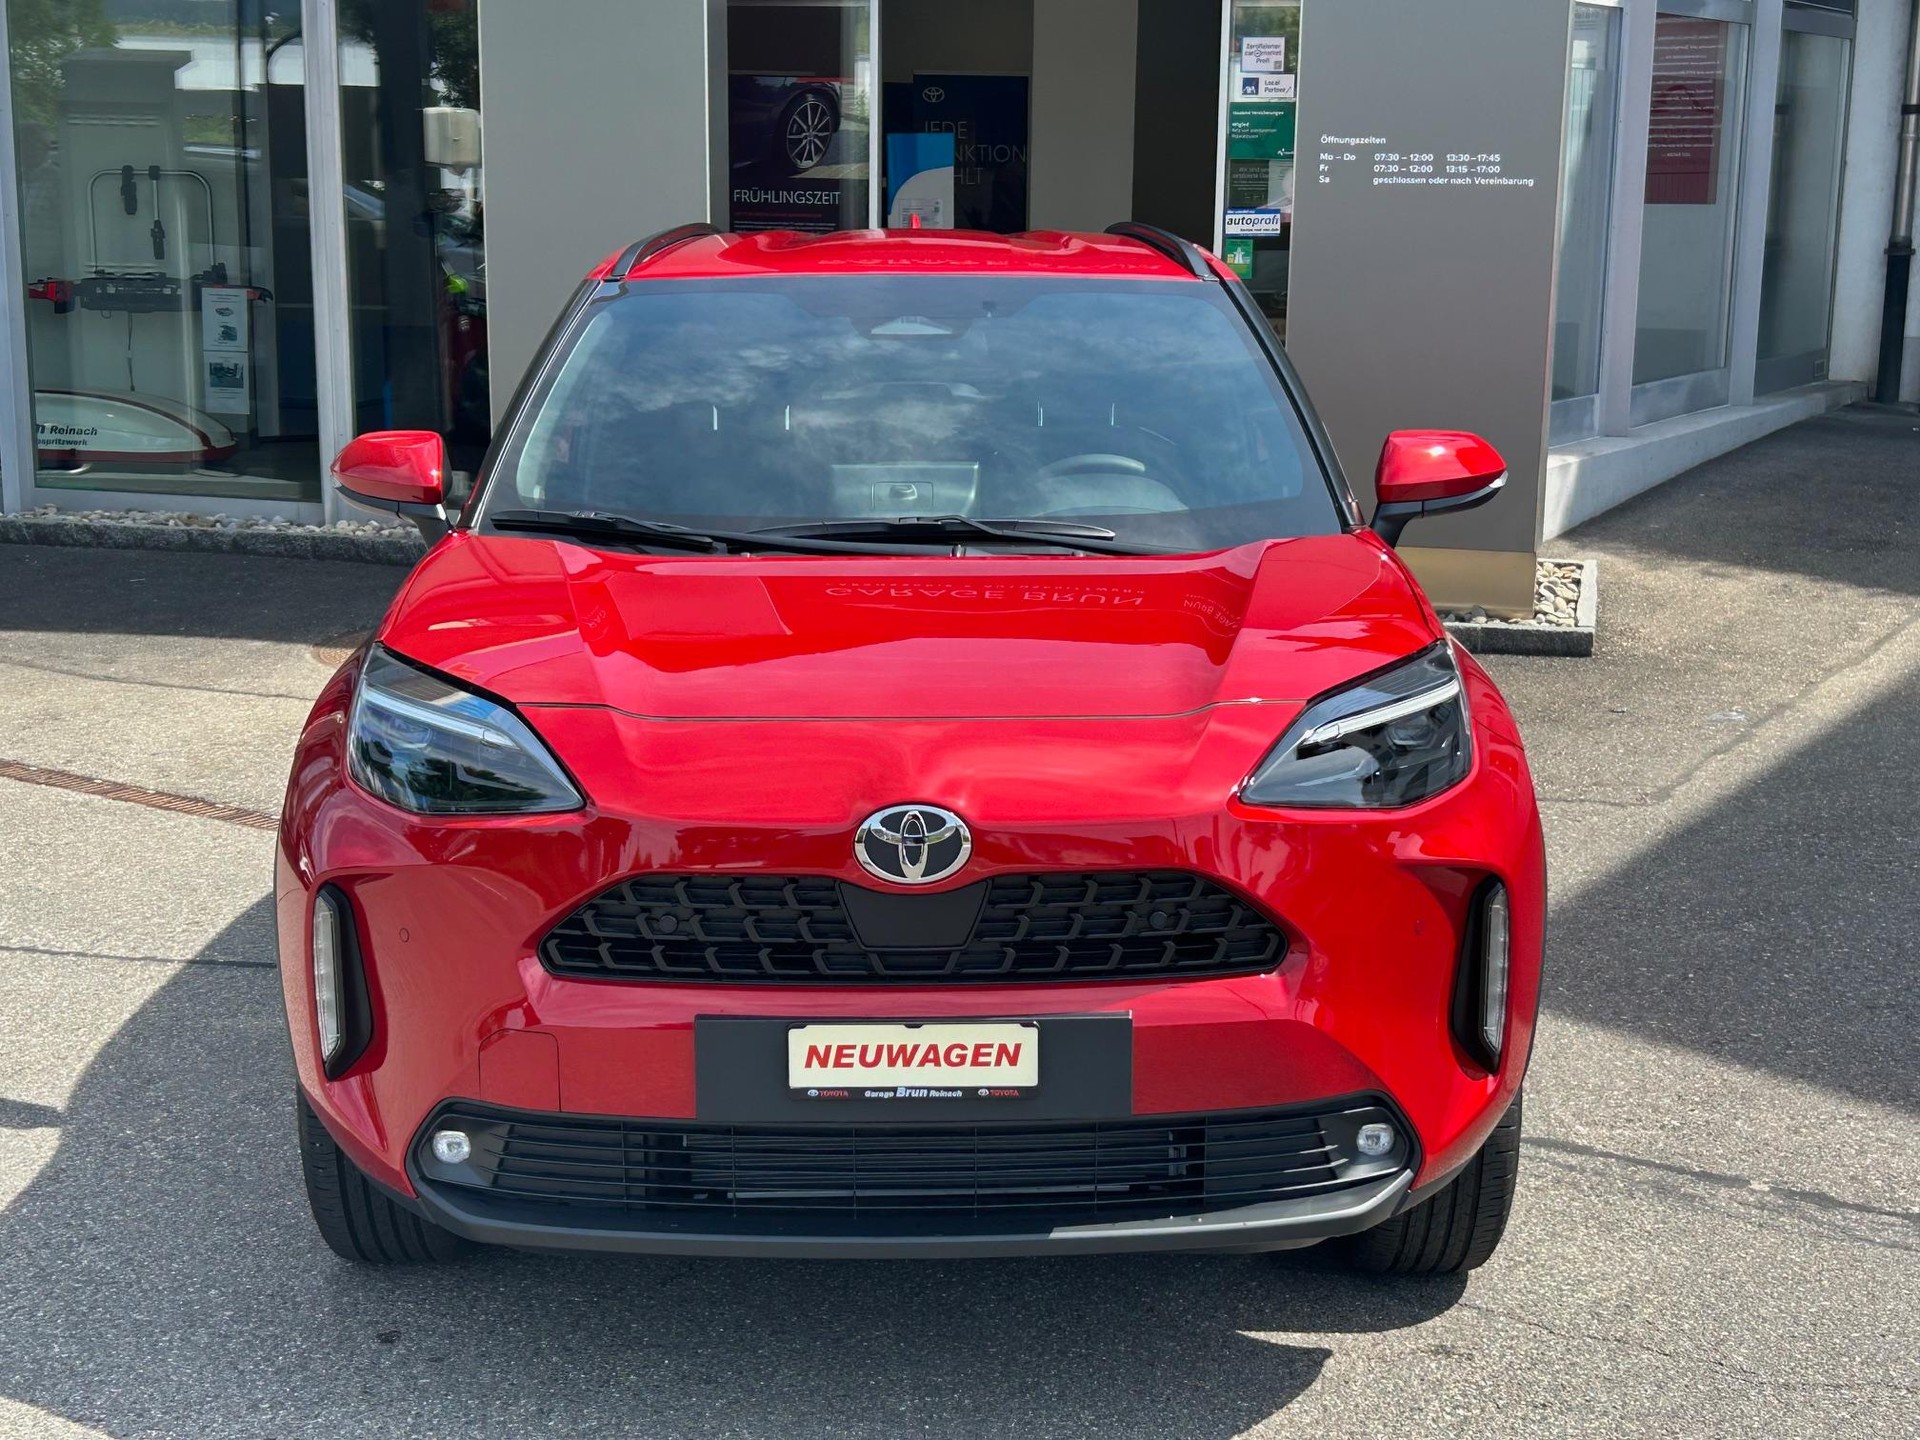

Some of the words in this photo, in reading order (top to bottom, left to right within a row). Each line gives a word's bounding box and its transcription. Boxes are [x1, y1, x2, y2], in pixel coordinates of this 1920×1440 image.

[1320, 134, 1386, 146] Öffnungszeiten
[954, 144, 1026, 162] NKTION
[1374, 153, 1399, 161] 07:30
[1409, 153, 1434, 161] 12:00
[1320, 164, 1328, 172] Fr
[1373, 164, 1398, 172] 07:30
[954, 167, 983, 185] HLT
[1319, 175, 1330, 183] Sa
[1373, 176, 1426, 185] geschlossen
[1428, 176, 1448, 184] oder
[1450, 176, 1471, 184] nach
[1474, 177, 1534, 187] Vereinbarung
[733, 187, 841, 205] FRÜHLINGSZEIT
[1226, 215, 1279, 227] autoprofi
[50, 425, 98, 436] Reinach
[804, 1042, 1022, 1069] NEUWAGEN
[819, 1090, 849, 1098] TOYOTA
[864, 1090, 894, 1099] Garage
[896, 1086, 928, 1098] Brun
[929, 1090, 963, 1098] Reinach
[989, 1089, 1020, 1097] TOYOTA
